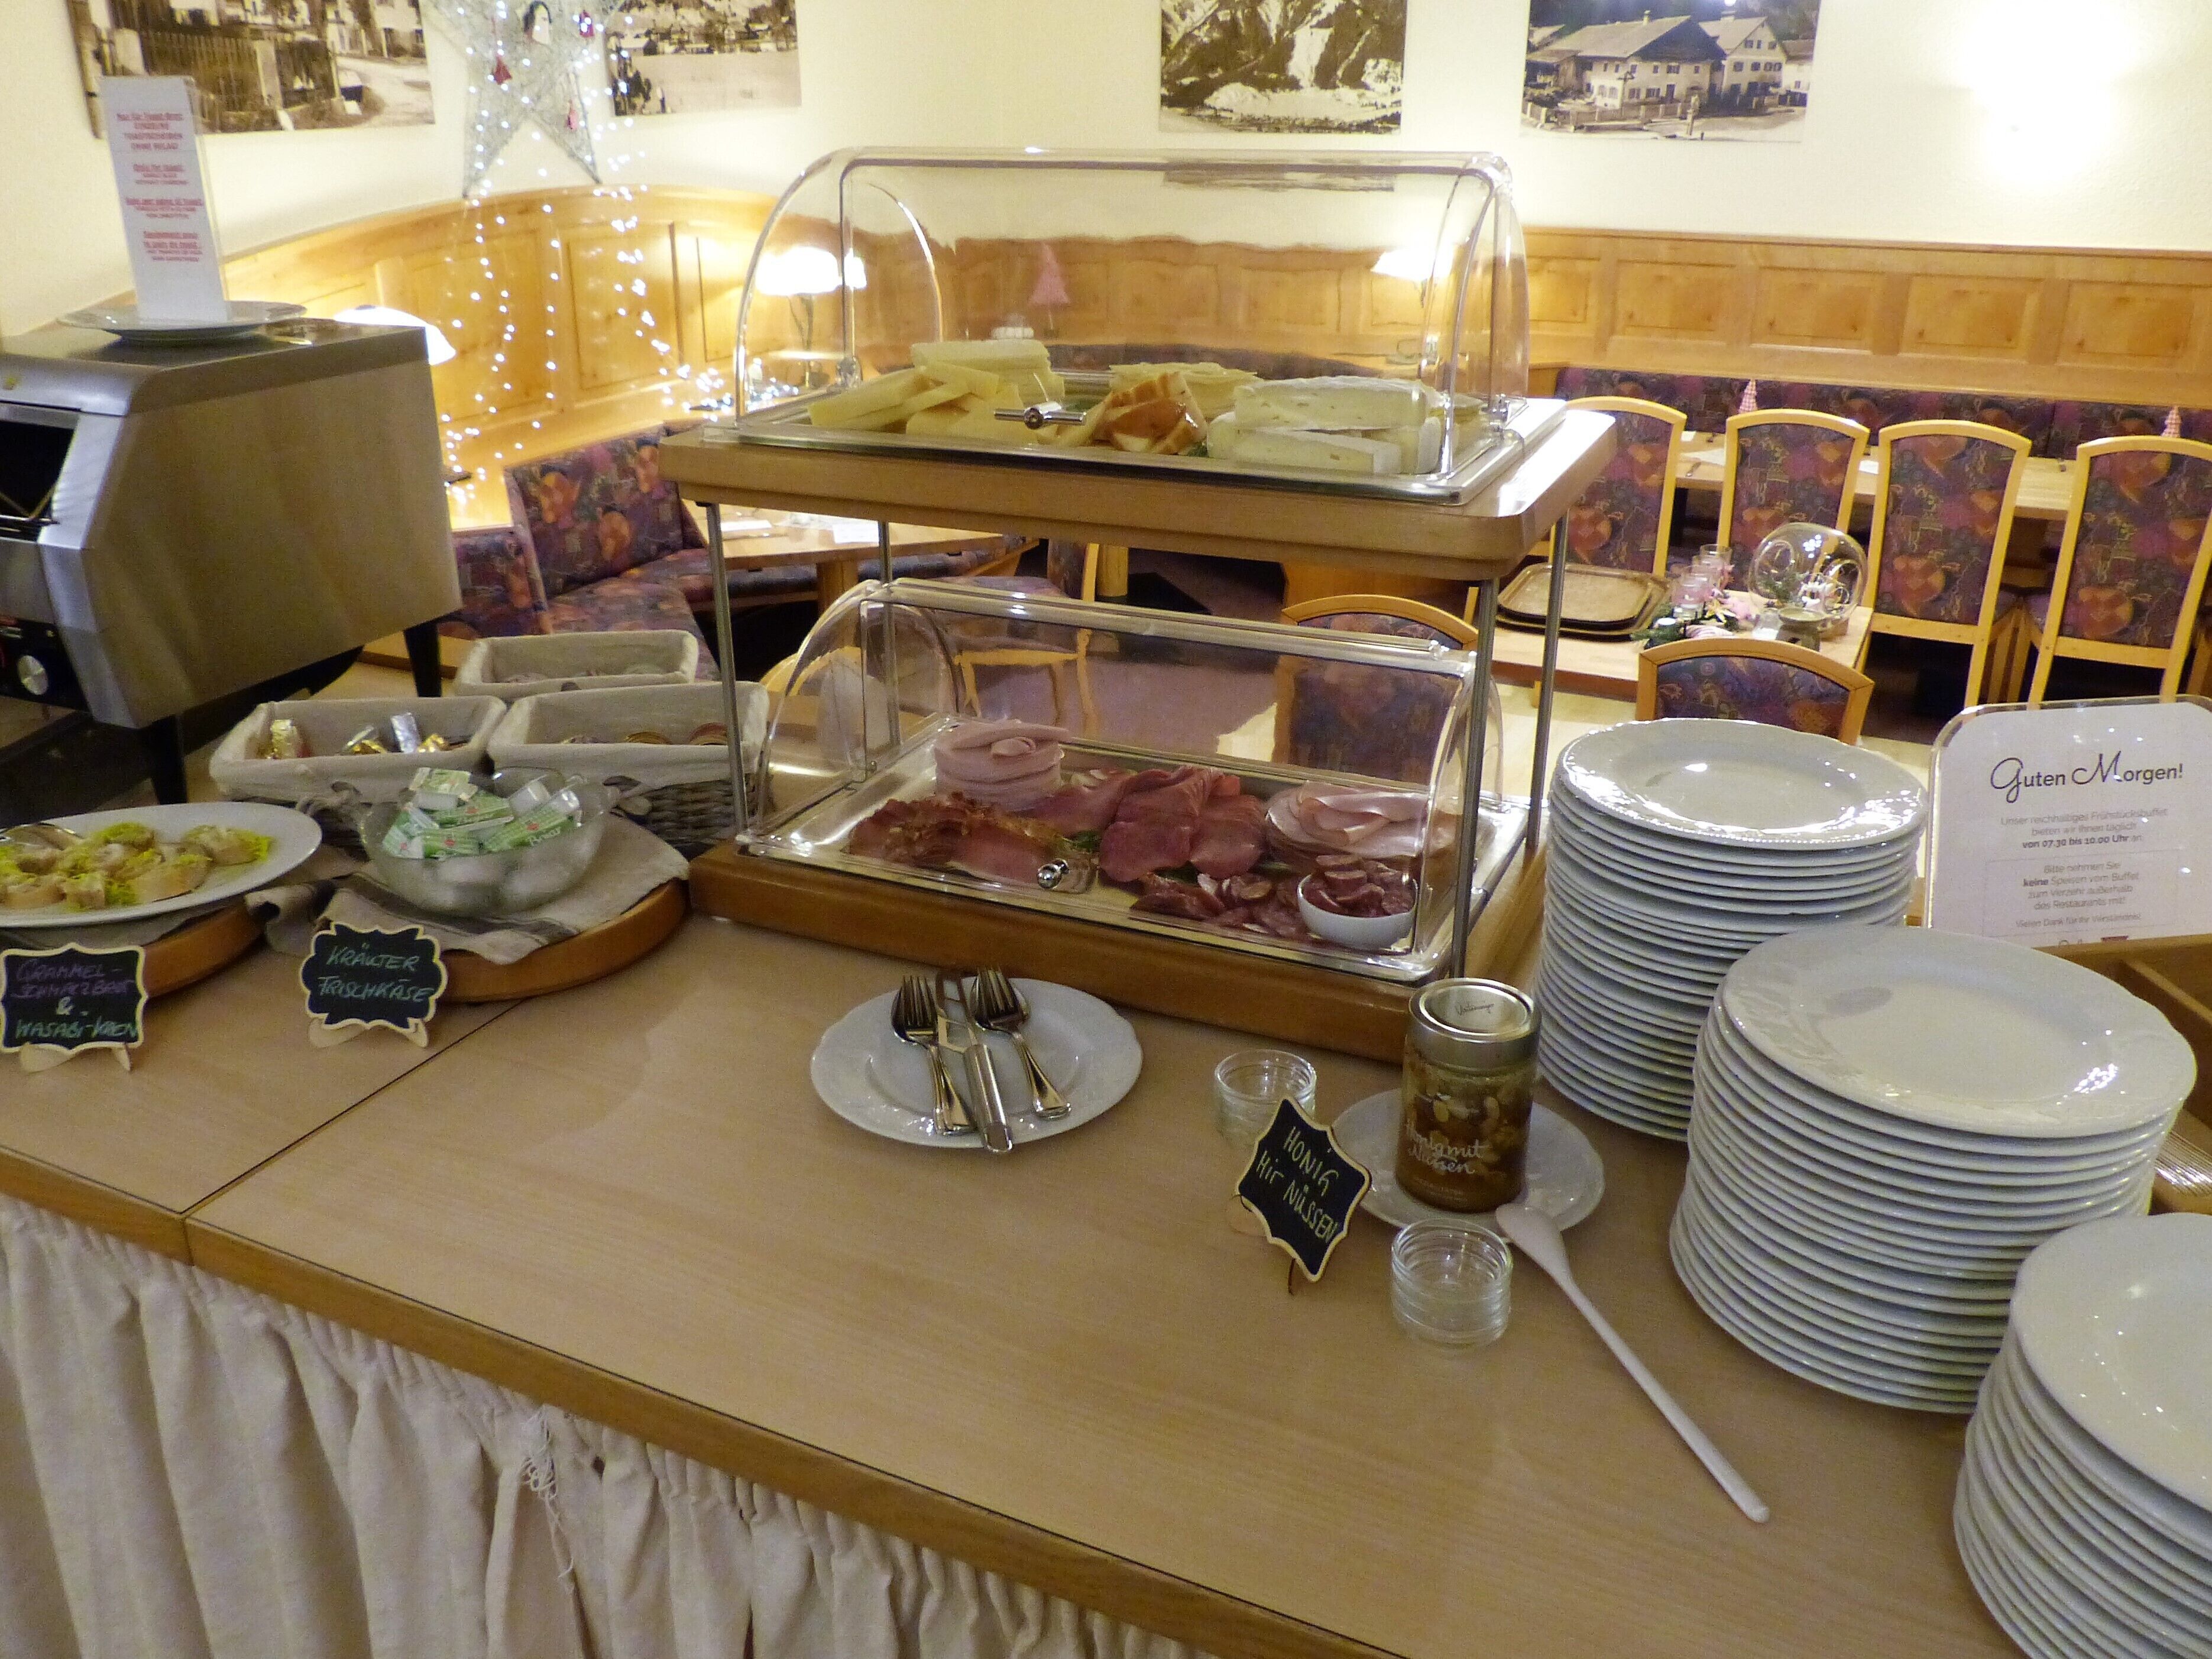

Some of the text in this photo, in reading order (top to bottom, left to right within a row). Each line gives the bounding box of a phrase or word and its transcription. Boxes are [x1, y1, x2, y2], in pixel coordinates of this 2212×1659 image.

[1991, 750, 2183, 803] Guten Morgen!
[2001, 817, 2028, 825] Unser
[2032, 828, 2060, 836] bieten
[2042, 839, 2067, 848] 07.30
[2069, 837, 2082, 845] bis
[2084, 836, 2109, 844] 10.00
[2112, 834, 2129, 843] Uhr
[2043, 865, 2065, 873] Bitte
[2106, 861, 2121, 870] Sie
[2023, 878, 2049, 887] keine
[2111, 871, 2139, 882] Buffet
[326, 942, 420, 971] KRÄUTER
[1283, 1125, 1339, 1197] HONIG
